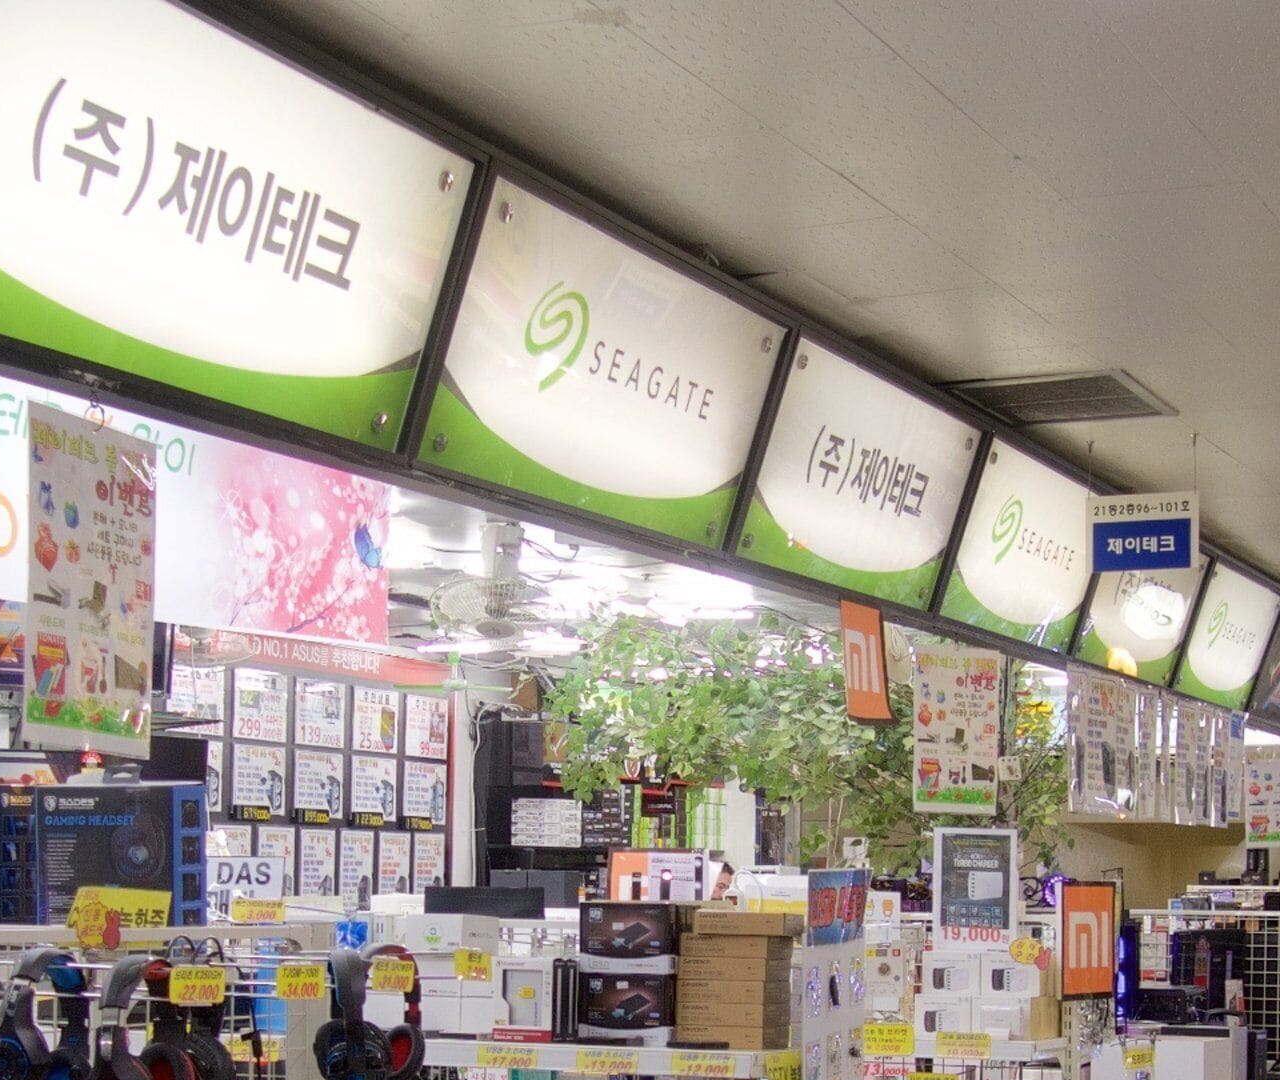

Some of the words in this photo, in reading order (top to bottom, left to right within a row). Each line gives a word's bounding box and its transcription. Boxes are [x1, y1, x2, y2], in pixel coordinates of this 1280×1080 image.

[589, 341, 715, 421] SEAGATE
[1020, 524, 1075, 572] SEAGATE
[1107, 535, 1175, 555] 제이테크
[263, 640, 288, 657] NO.1
[332, 647, 380, 675] 추천합니다!
[57, 797, 96, 808] SADES
[45, 815, 85, 827] GAMING
[87, 814, 135, 827] HEADSET
[217, 862, 271, 885] DAS
